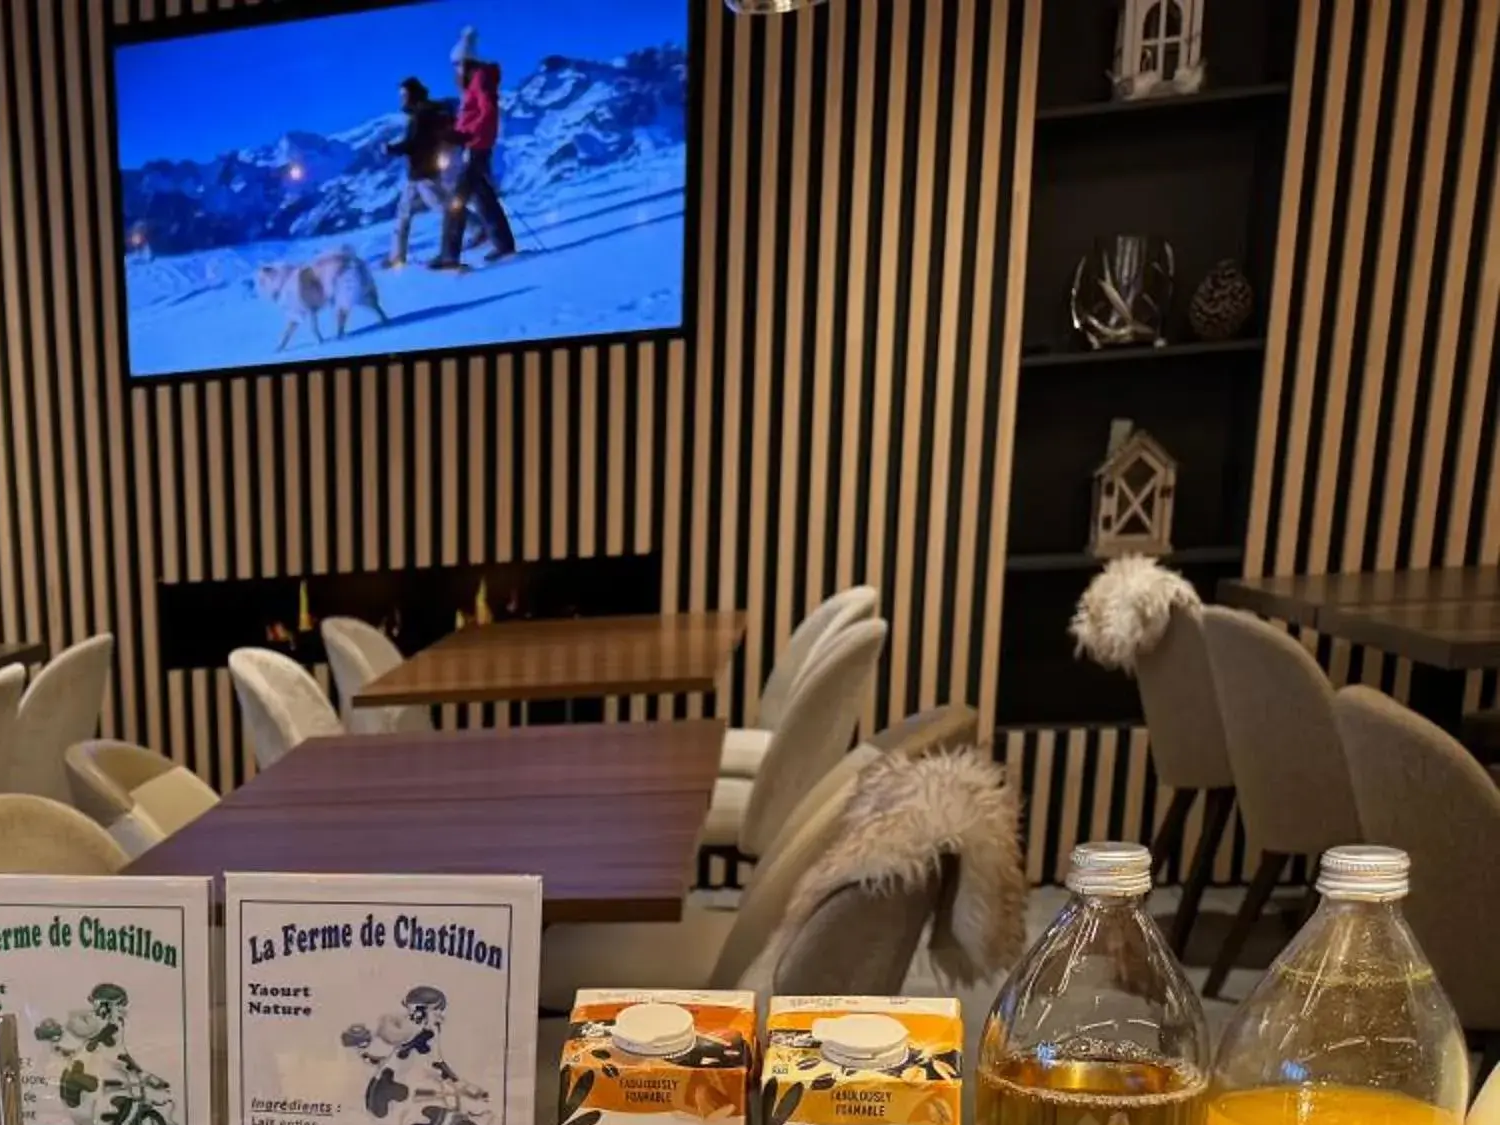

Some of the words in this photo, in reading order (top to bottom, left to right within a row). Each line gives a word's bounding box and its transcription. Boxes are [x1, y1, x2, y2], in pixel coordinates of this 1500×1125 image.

[48, 915, 71, 947] de
[79, 916, 177, 968] Chatillon
[249, 936, 275, 964] La
[282, 923, 352, 956] Ferme
[360, 914, 386, 947] de
[393, 915, 503, 969] Chatillon
[249, 983, 312, 997] Yaourt
[249, 1001, 312, 1016] Nature
